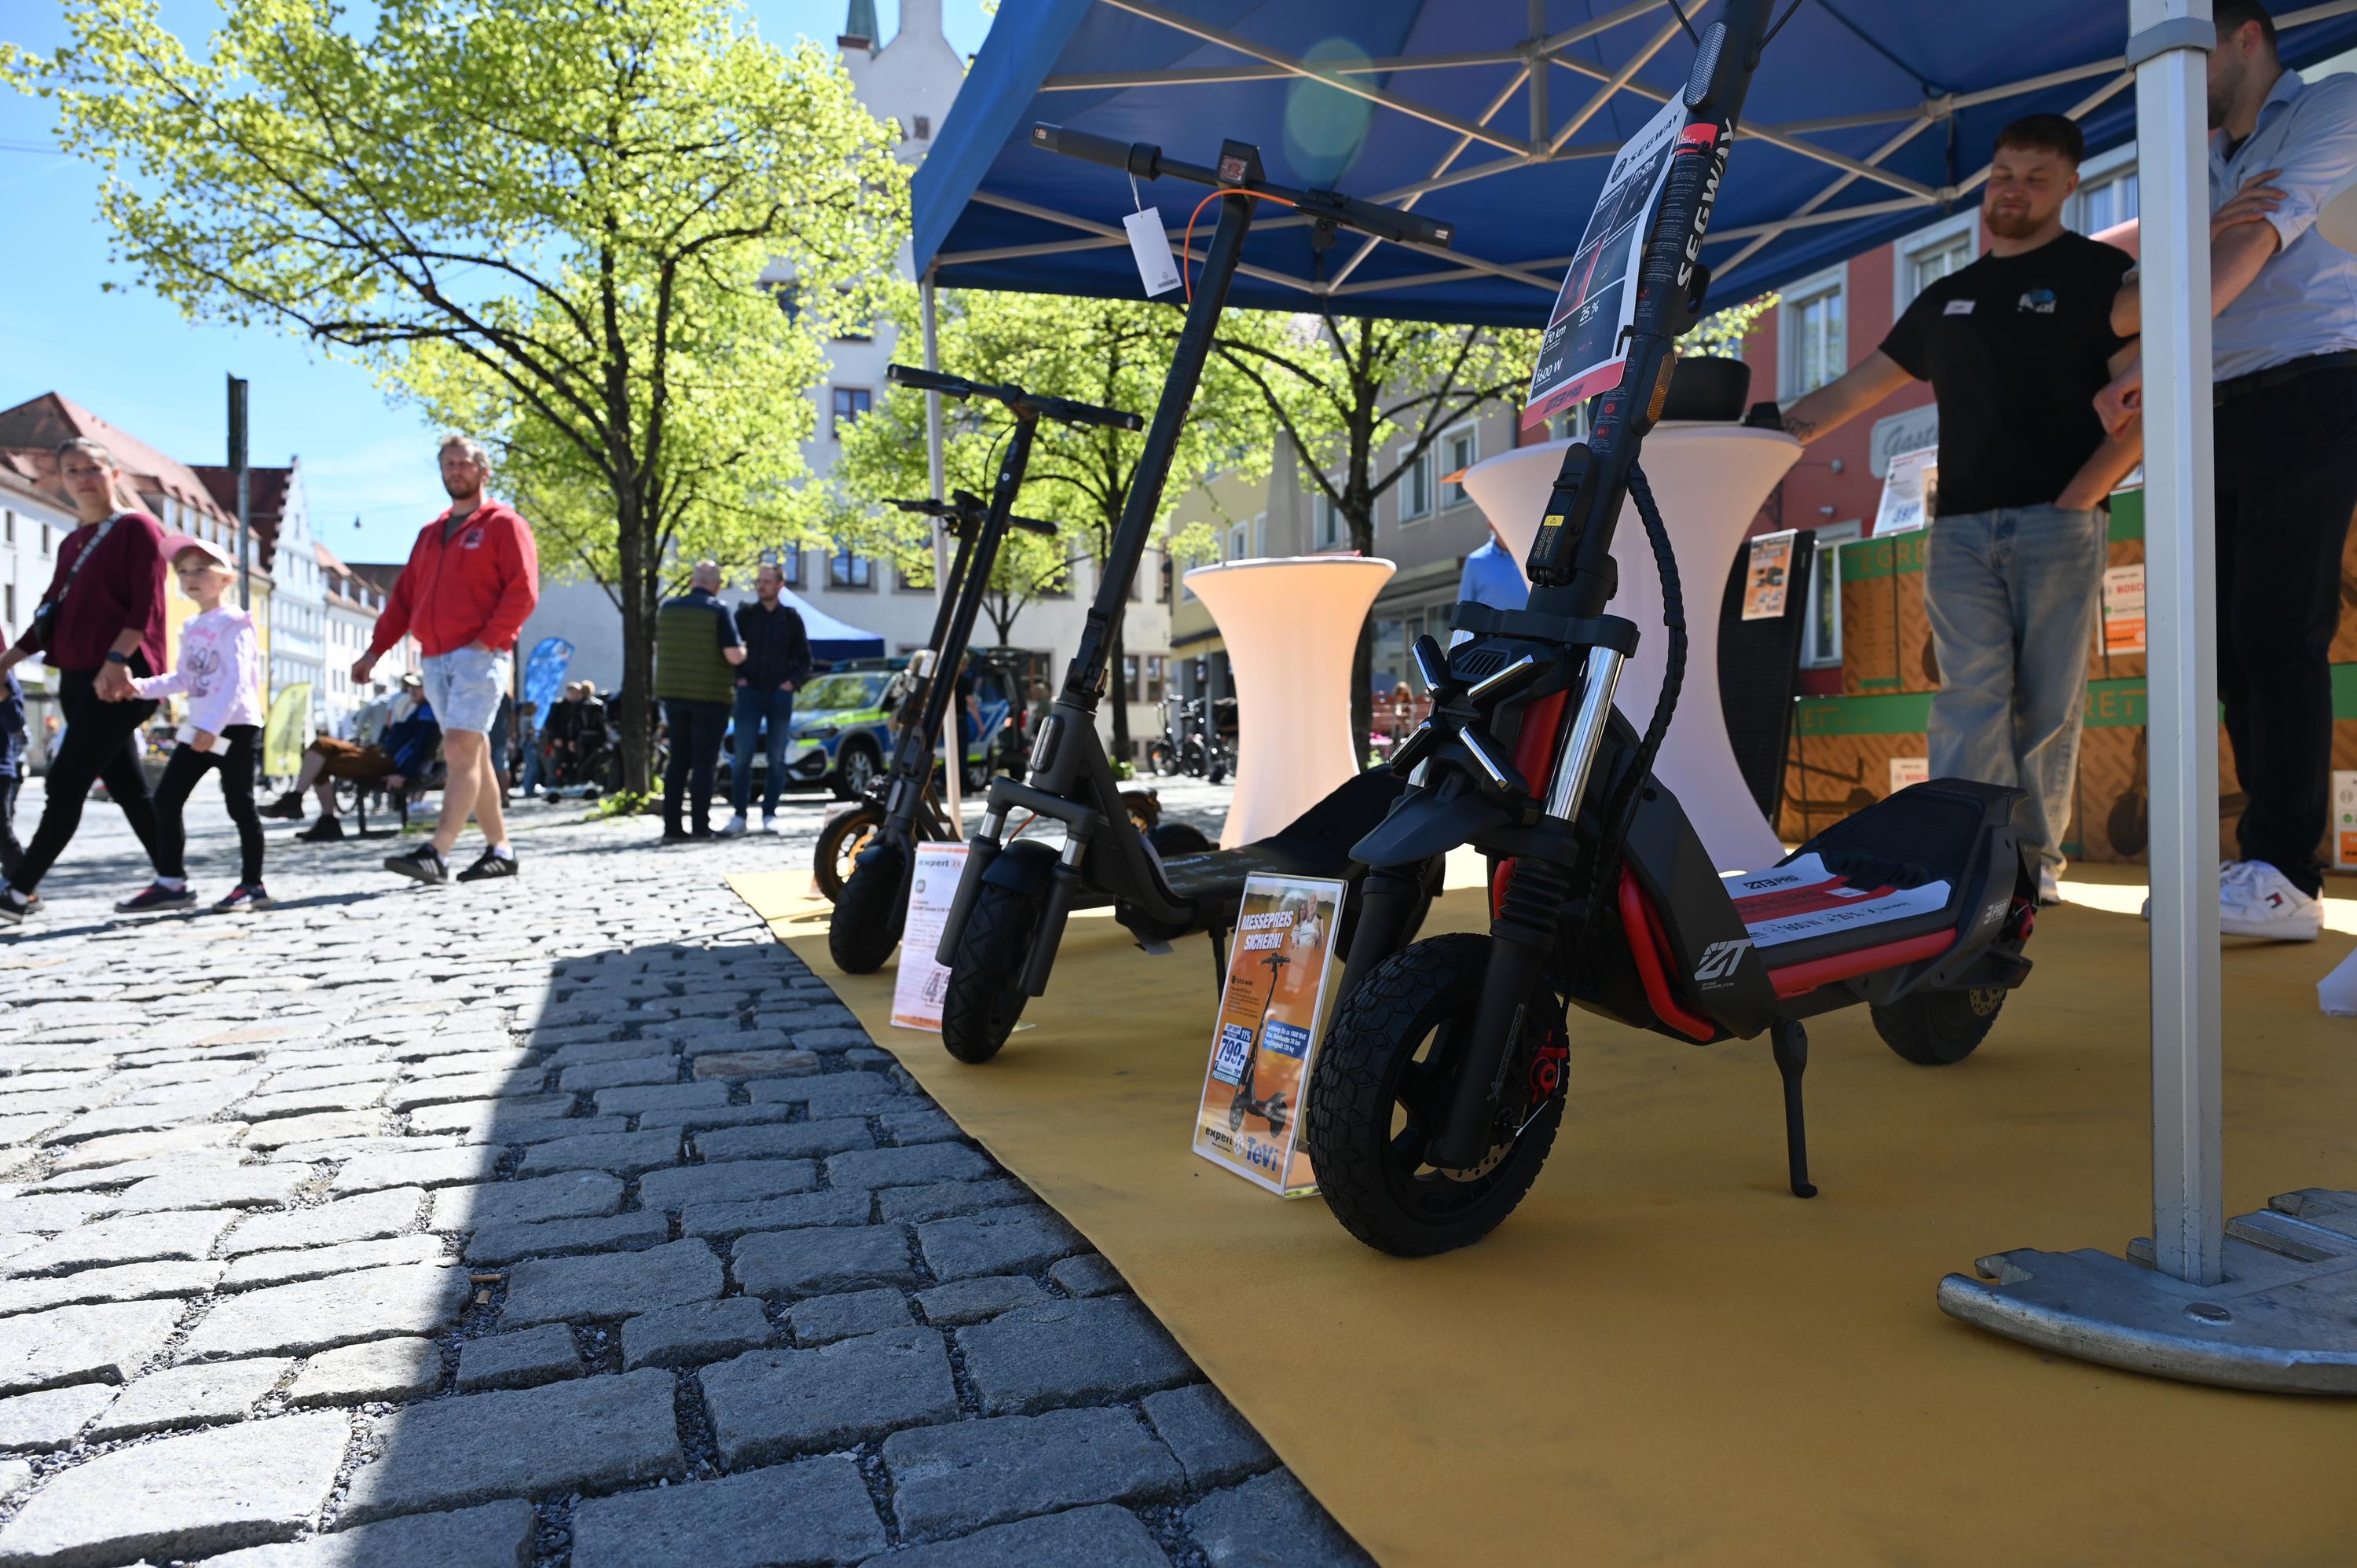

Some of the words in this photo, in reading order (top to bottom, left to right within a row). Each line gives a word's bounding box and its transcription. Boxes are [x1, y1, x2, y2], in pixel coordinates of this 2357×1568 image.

[1628, 108, 1681, 165] SEGWAY
[1677, 117, 1735, 291] SEGWAY
[1579, 306, 1591, 322] 25
[1592, 300, 1600, 315] %
[1545, 331, 1555, 346] 70
[1555, 325, 1567, 339] km
[1535, 364, 1552, 384] 1600
[1554, 357, 1563, 372] W
[918, 859, 949, 868] expert
[1241, 910, 1294, 931] MESSEPREIS
[1244, 932, 1284, 951] SICHERN!
[1241, 1029, 1251, 1042] 11%
[1205, 1127, 1233, 1145] expert
[1246, 1136, 1279, 1171] TeVi
